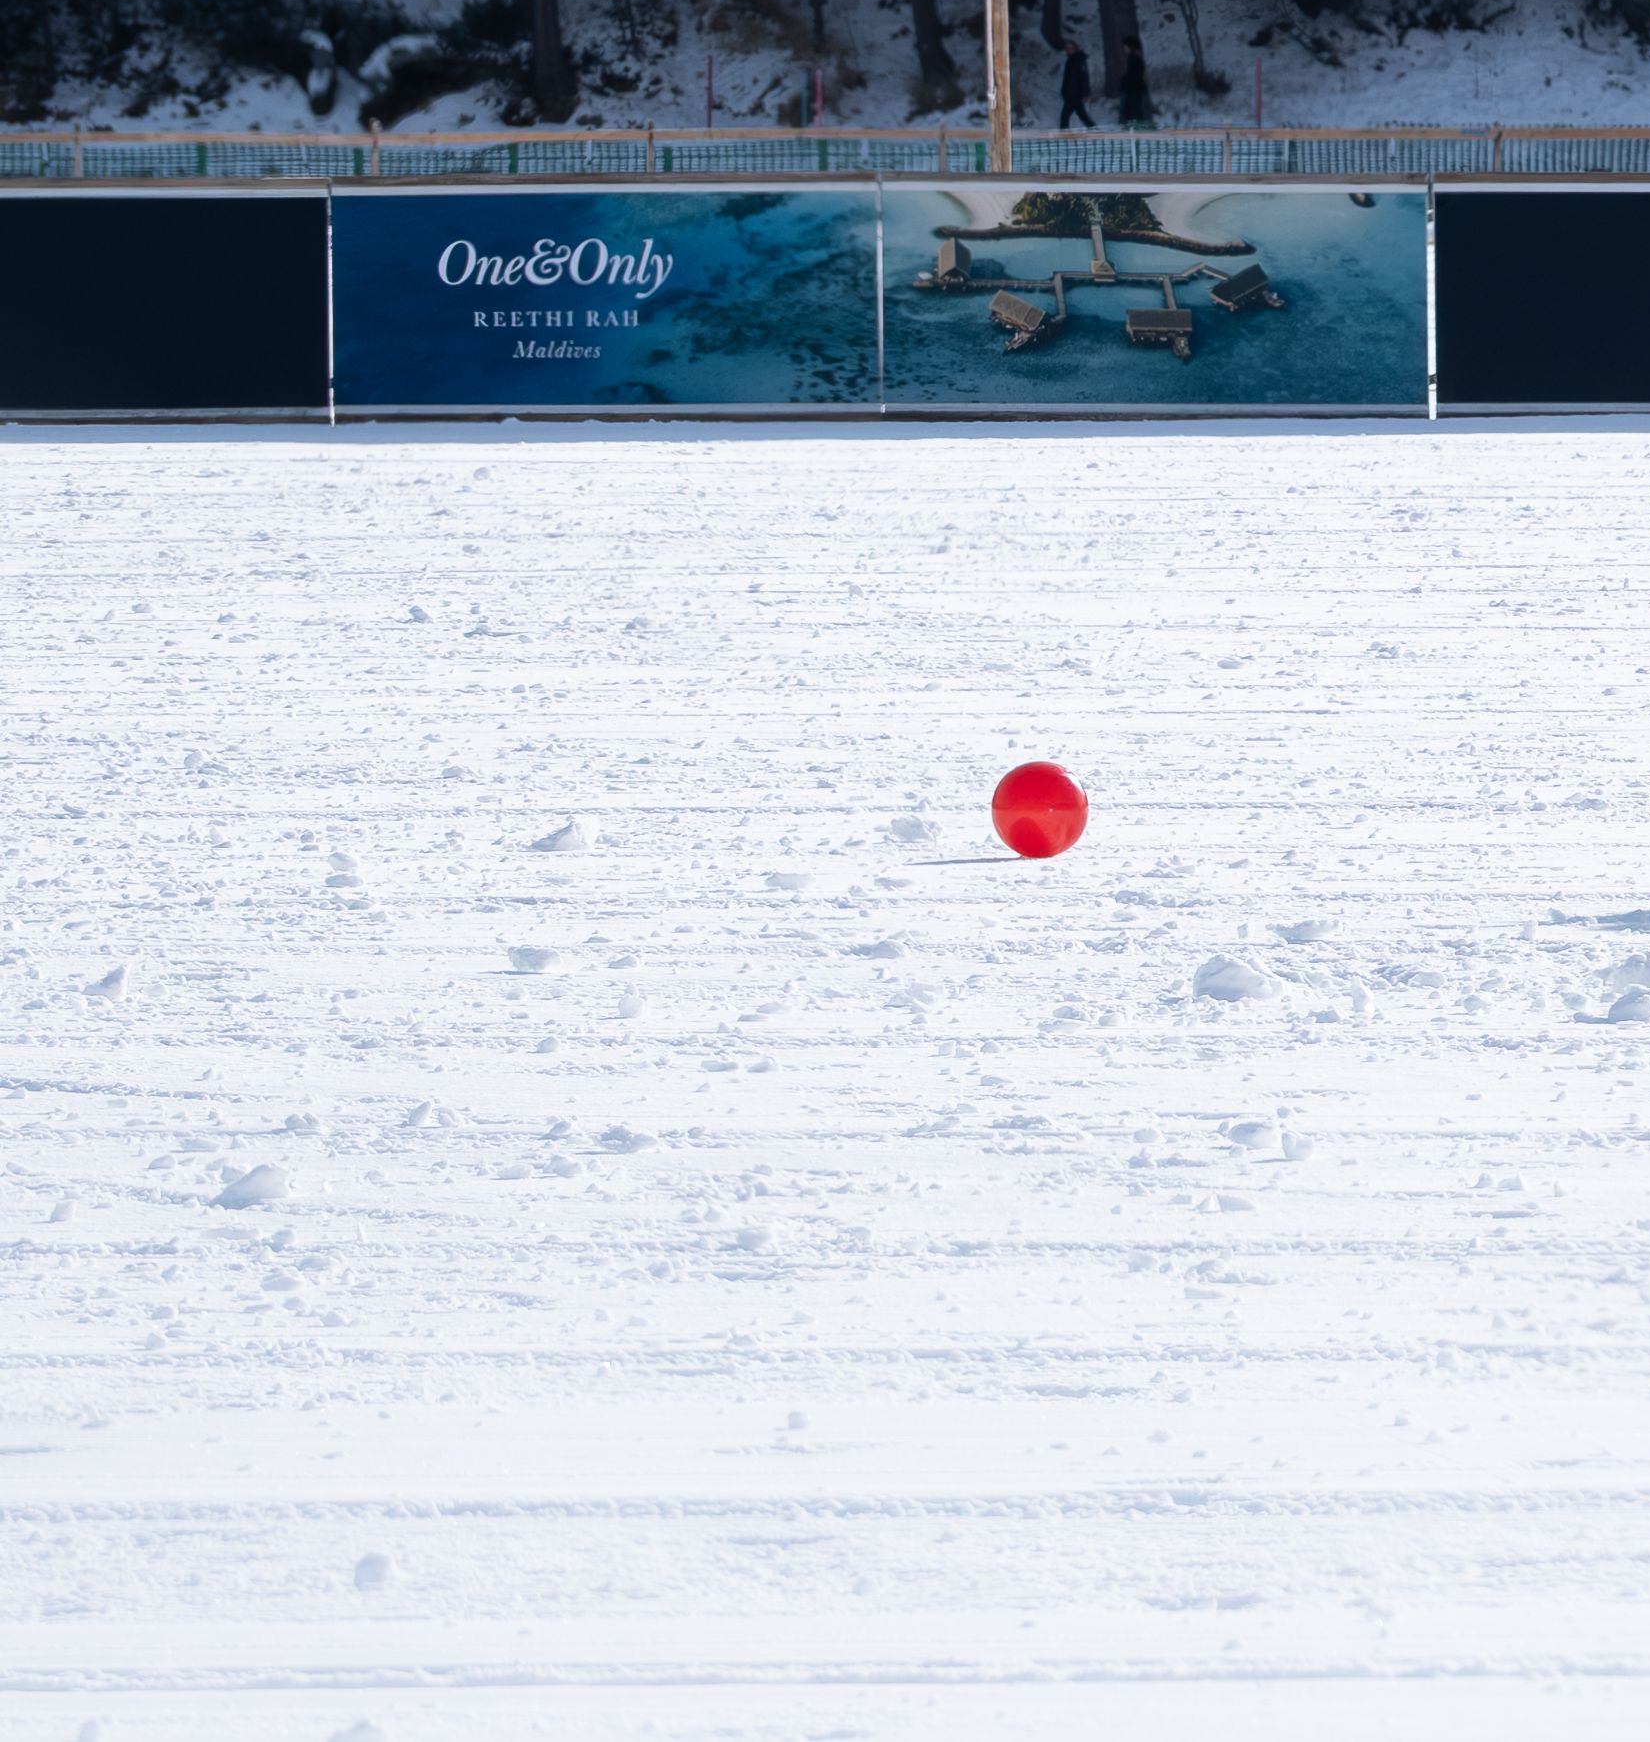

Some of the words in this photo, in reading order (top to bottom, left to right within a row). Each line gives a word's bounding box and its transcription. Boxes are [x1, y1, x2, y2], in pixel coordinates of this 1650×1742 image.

[437, 237, 674, 300] One&Only
[473, 310, 574, 328] REETHI
[586, 310, 639, 328] RAH
[512, 340, 602, 359] Maldives
